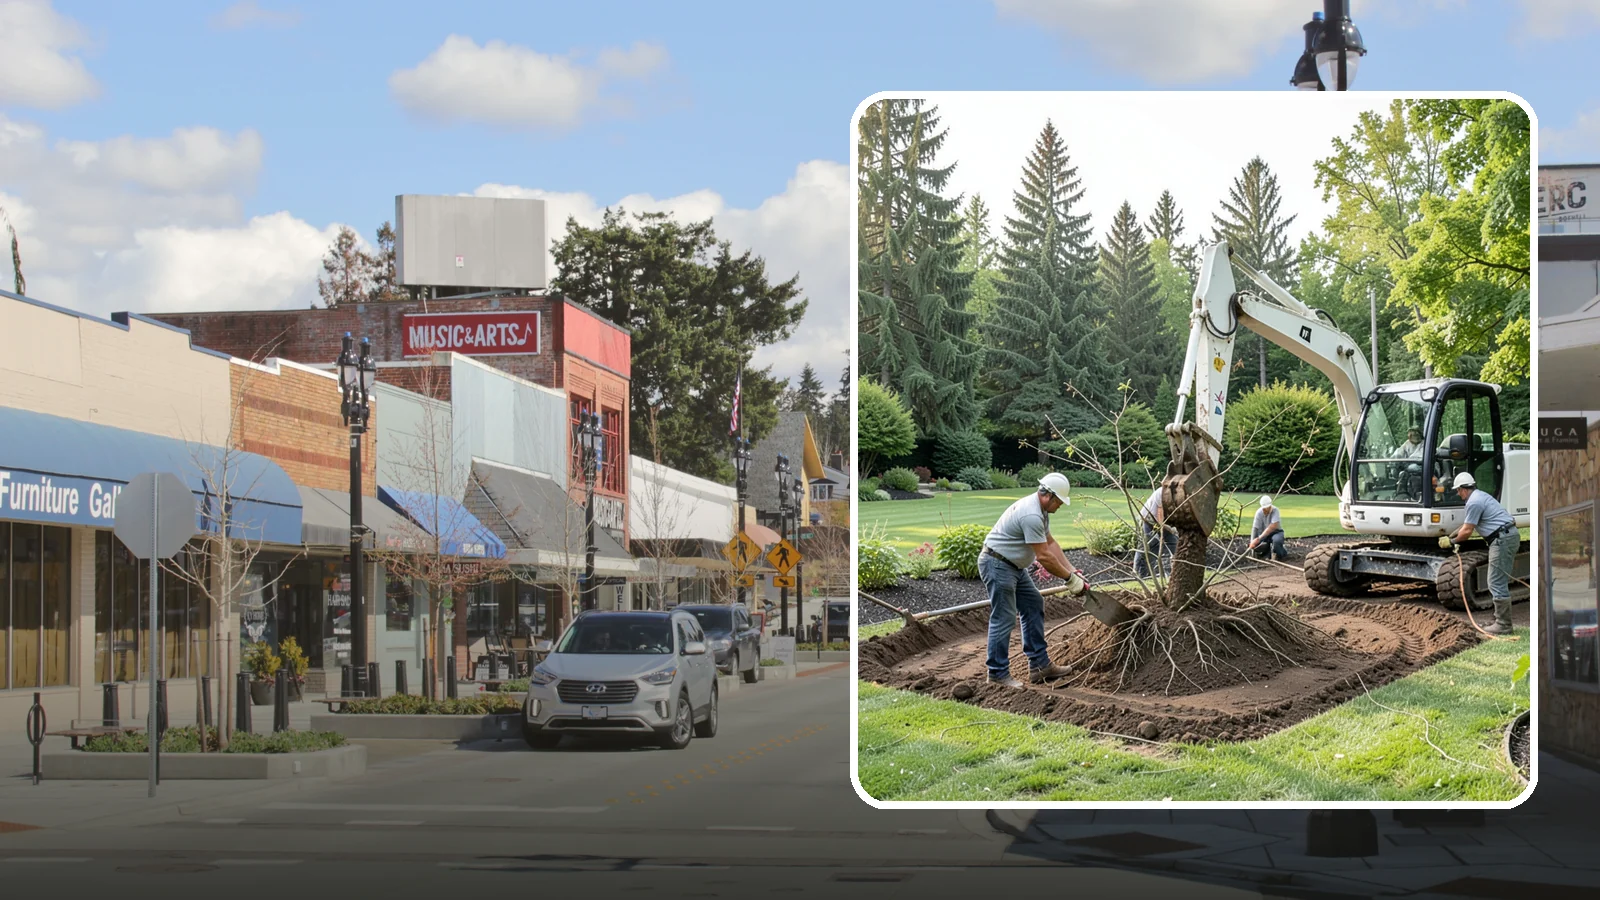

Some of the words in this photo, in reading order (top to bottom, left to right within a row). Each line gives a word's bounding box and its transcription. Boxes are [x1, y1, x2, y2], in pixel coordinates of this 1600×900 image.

[0, 471, 79, 516] Furniture
[89, 482, 121, 519] Gal
[453, 563, 479, 574] SUSHI
